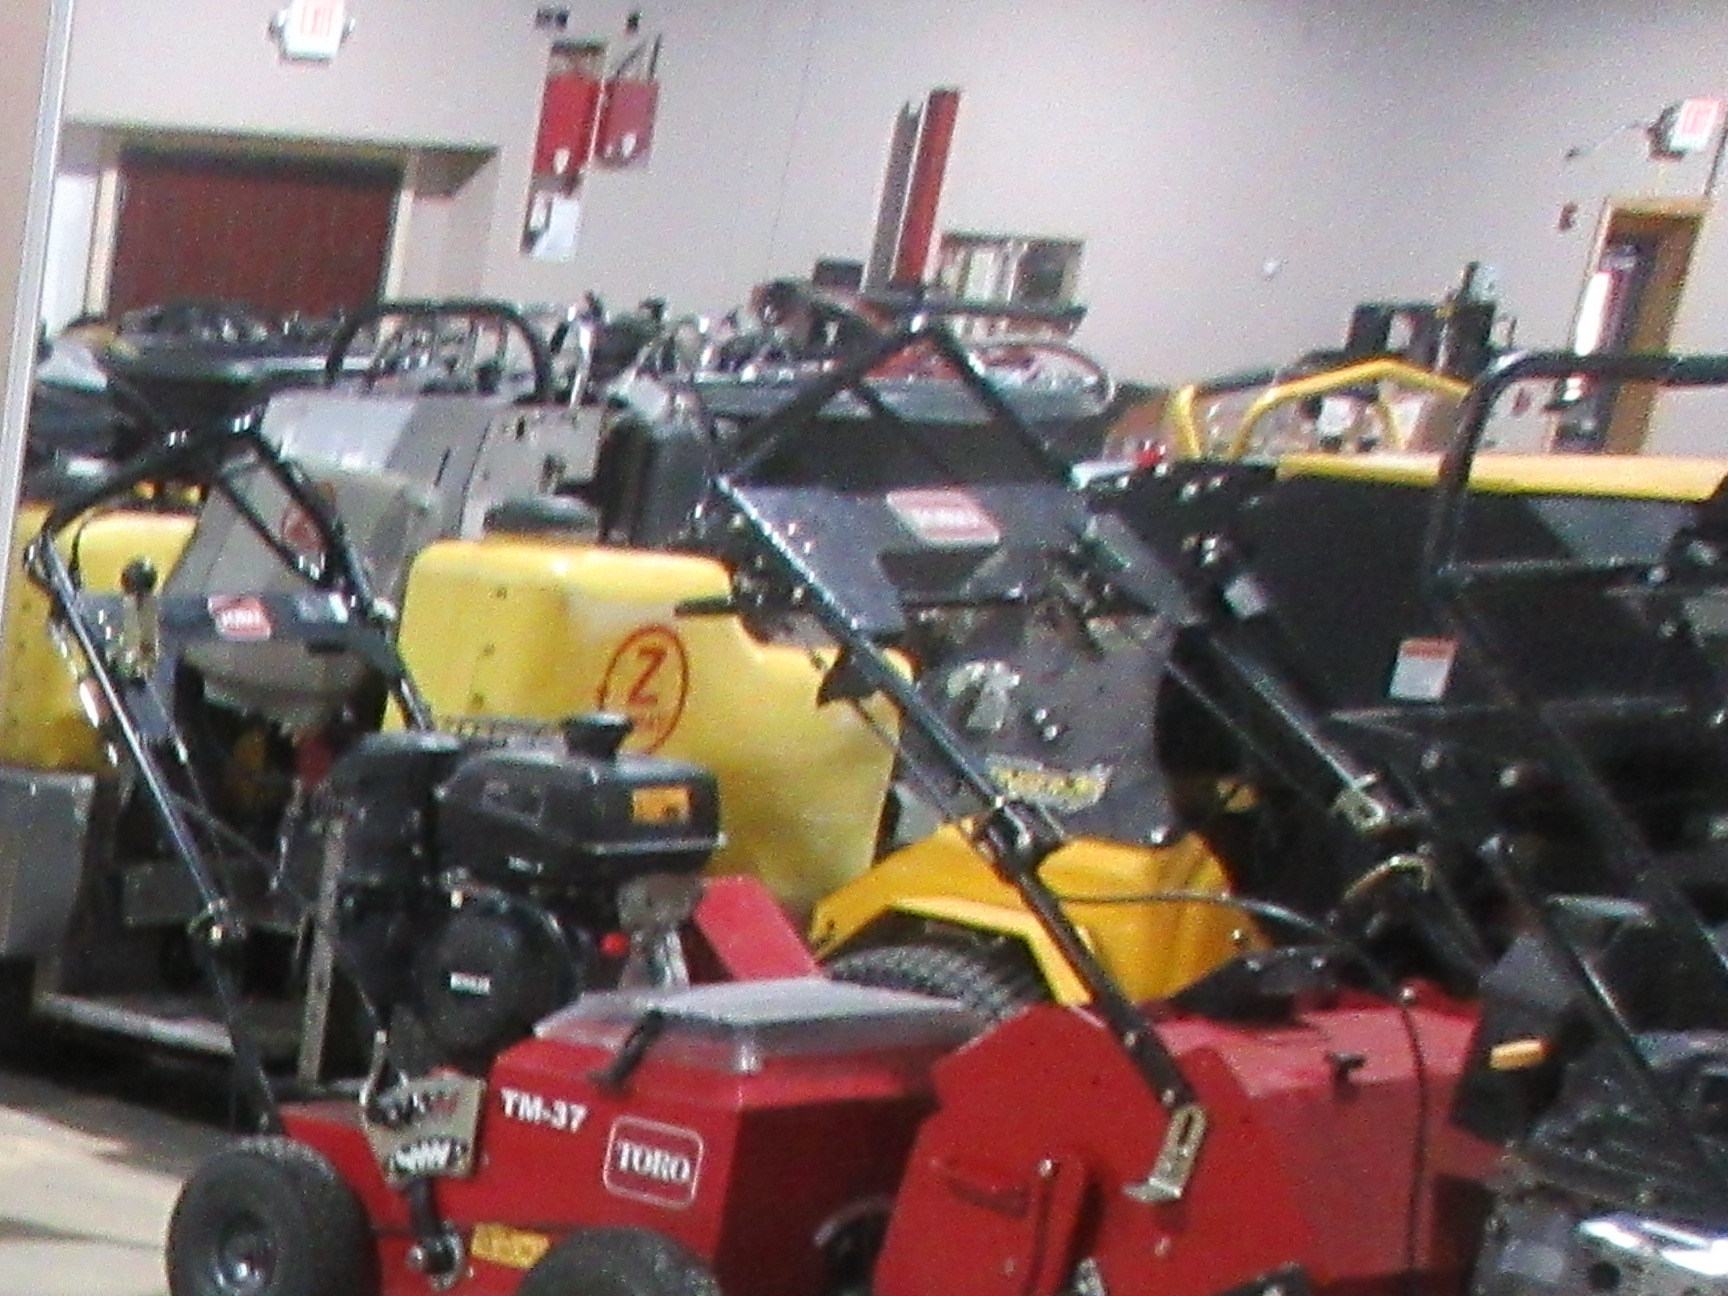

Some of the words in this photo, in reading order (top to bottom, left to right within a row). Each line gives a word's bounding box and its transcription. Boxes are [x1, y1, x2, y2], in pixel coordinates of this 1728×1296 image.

[627, 647, 668, 706] Z
[499, 1086, 588, 1135] TM-37
[617, 1139, 692, 1184] TORO
